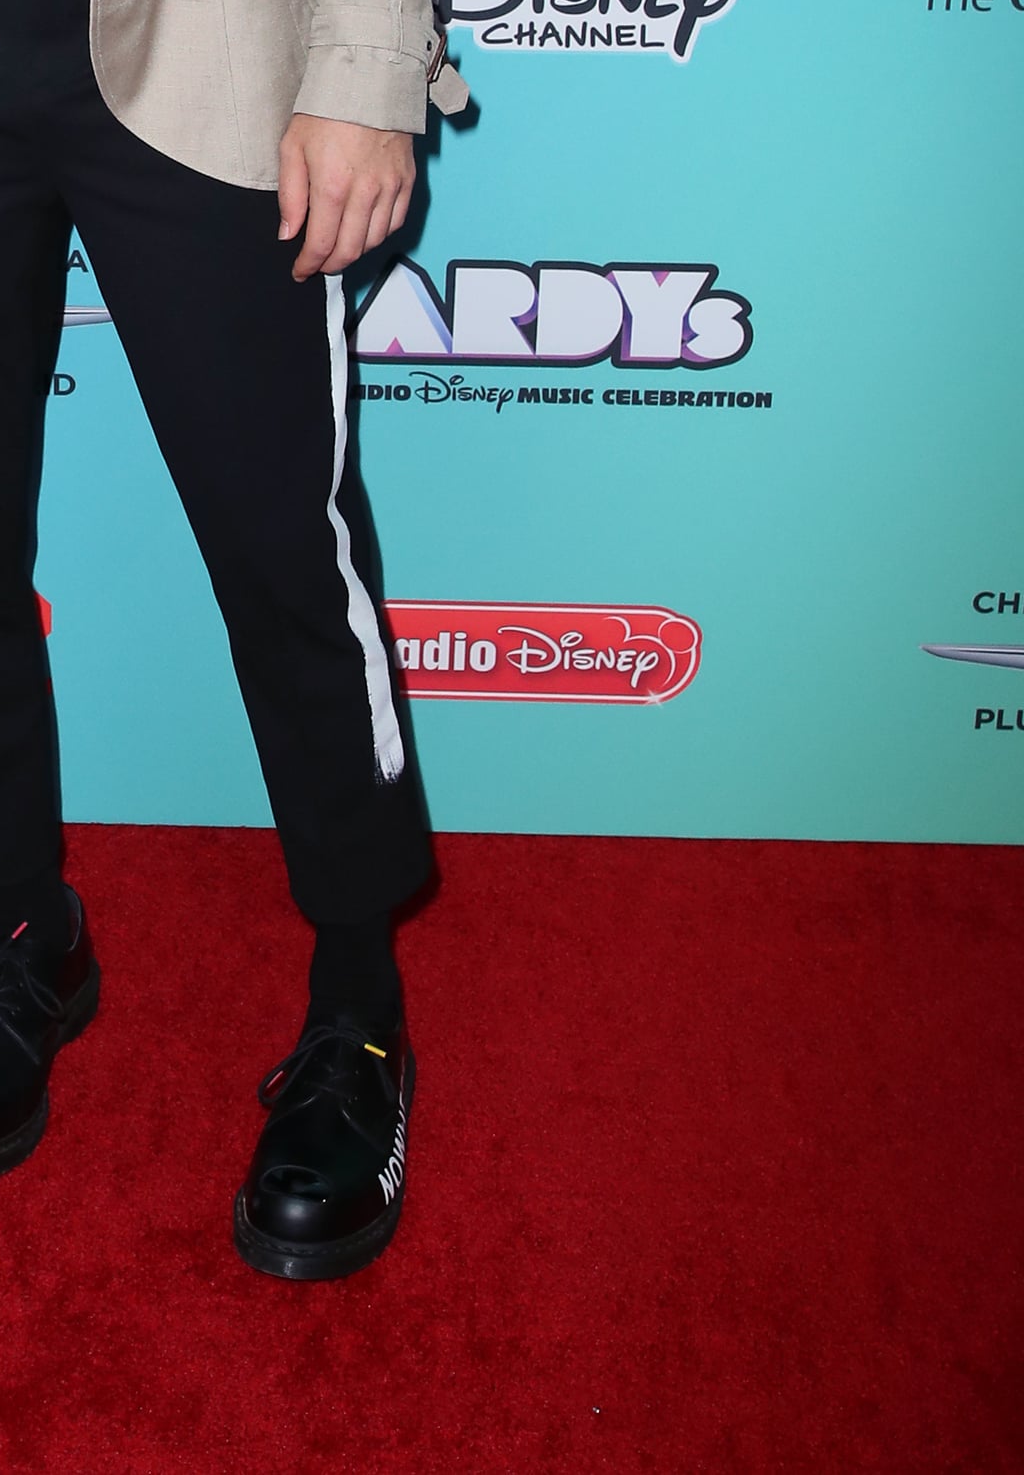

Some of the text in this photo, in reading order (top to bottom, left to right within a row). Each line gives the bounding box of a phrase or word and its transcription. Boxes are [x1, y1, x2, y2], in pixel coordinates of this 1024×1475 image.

[481, 21, 666, 48] CHANNEL
[517, 387, 595, 405] MUSIC
[602, 389, 773, 408] CELEBRATION
[395, 626, 659, 688] adio Disney
